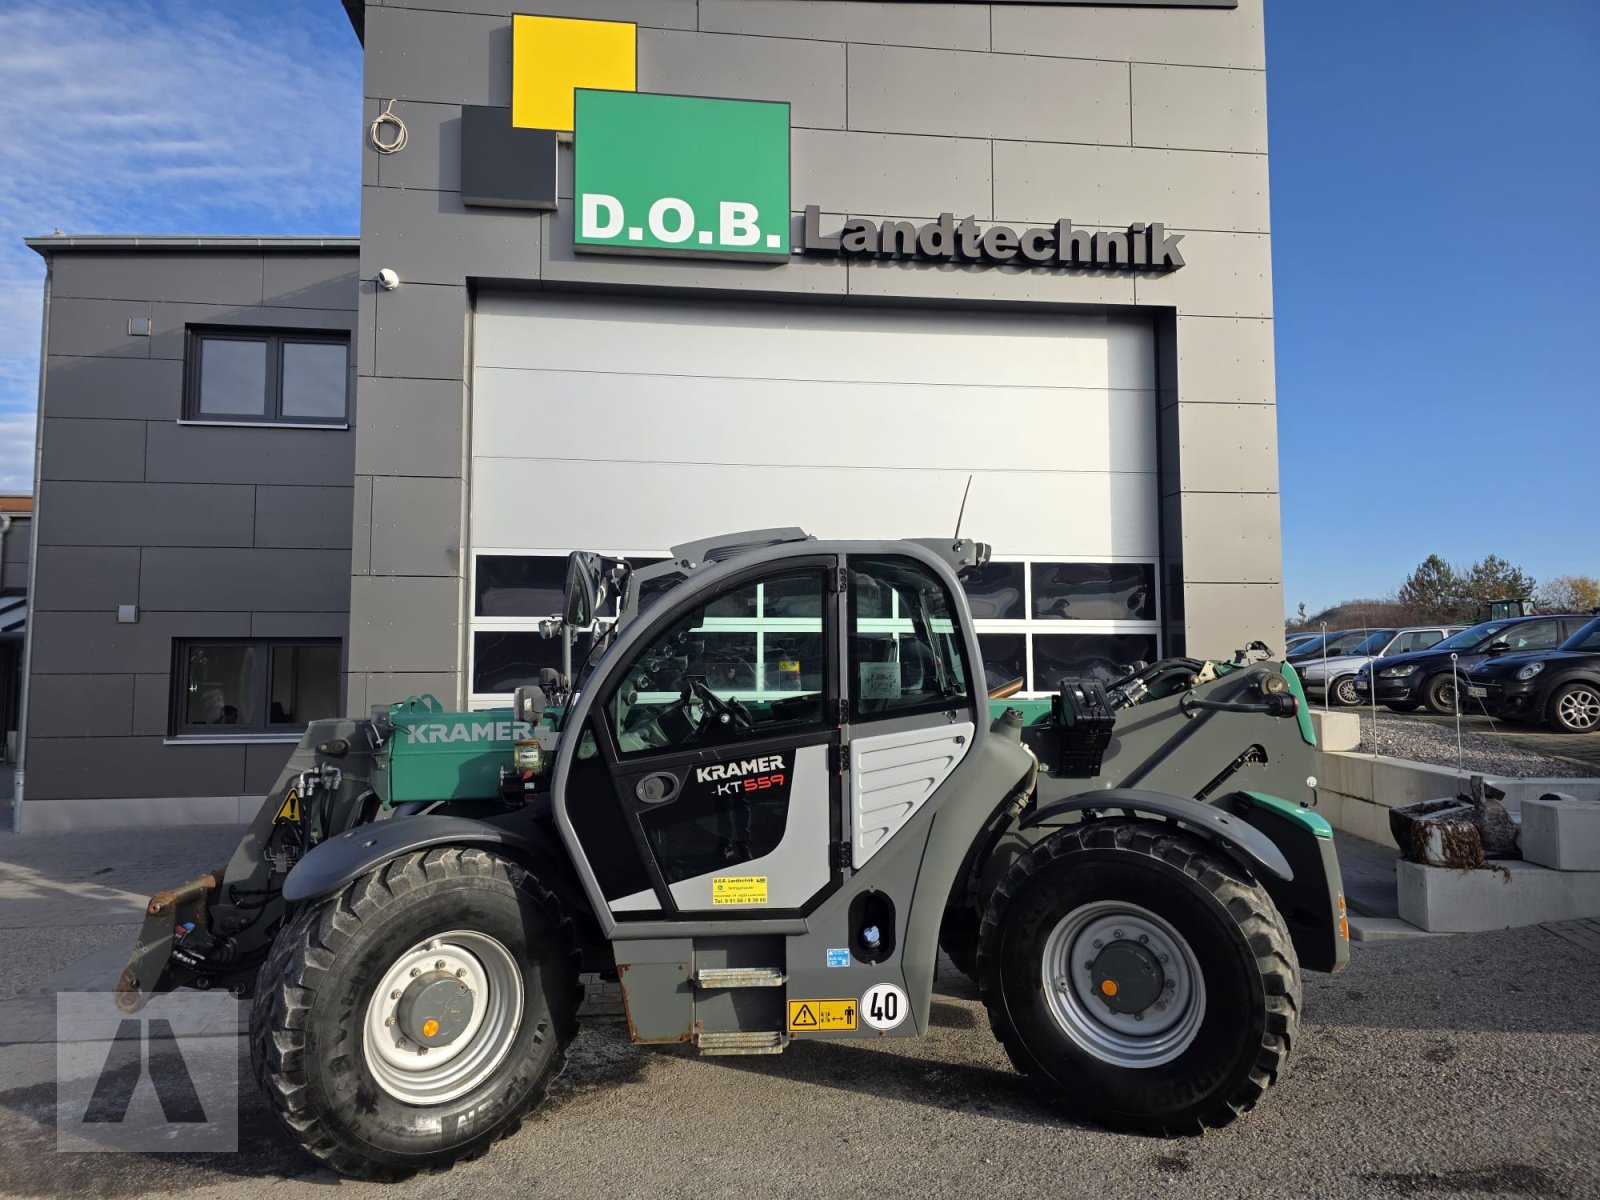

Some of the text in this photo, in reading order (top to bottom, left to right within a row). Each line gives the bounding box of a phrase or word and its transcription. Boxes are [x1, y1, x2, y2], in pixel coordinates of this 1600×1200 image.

[582, 193, 781, 248] D.O.B.
[805, 204, 1187, 269] Landtechnik
[407, 721, 533, 744] KRAMER
[696, 755, 786, 783] KRAMER
[870, 992, 898, 1021] 40
